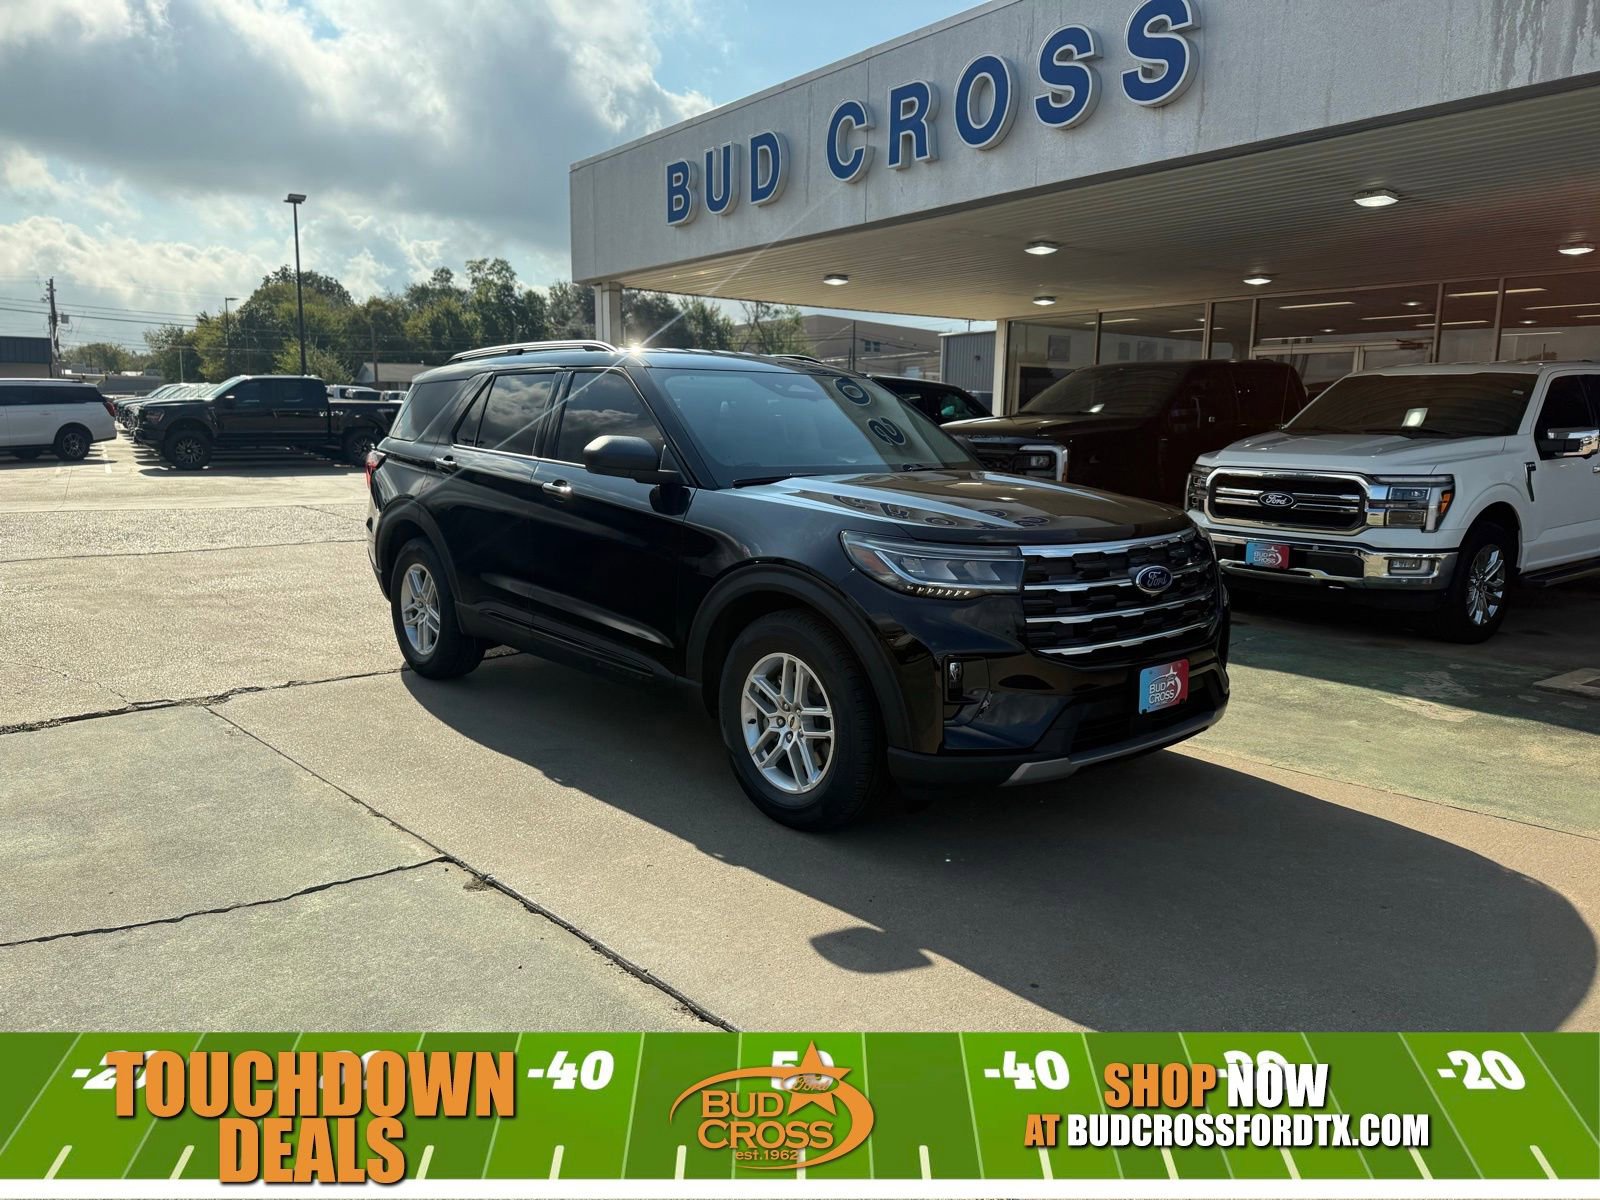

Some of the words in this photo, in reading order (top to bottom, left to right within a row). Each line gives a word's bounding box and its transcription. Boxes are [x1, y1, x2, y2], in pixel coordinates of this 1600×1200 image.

[666, 130, 788, 226] BUD
[825, 0, 1200, 184] CROSS
[1149, 682, 1166, 694] BUD
[1149, 690, 1175, 704] CROSS
